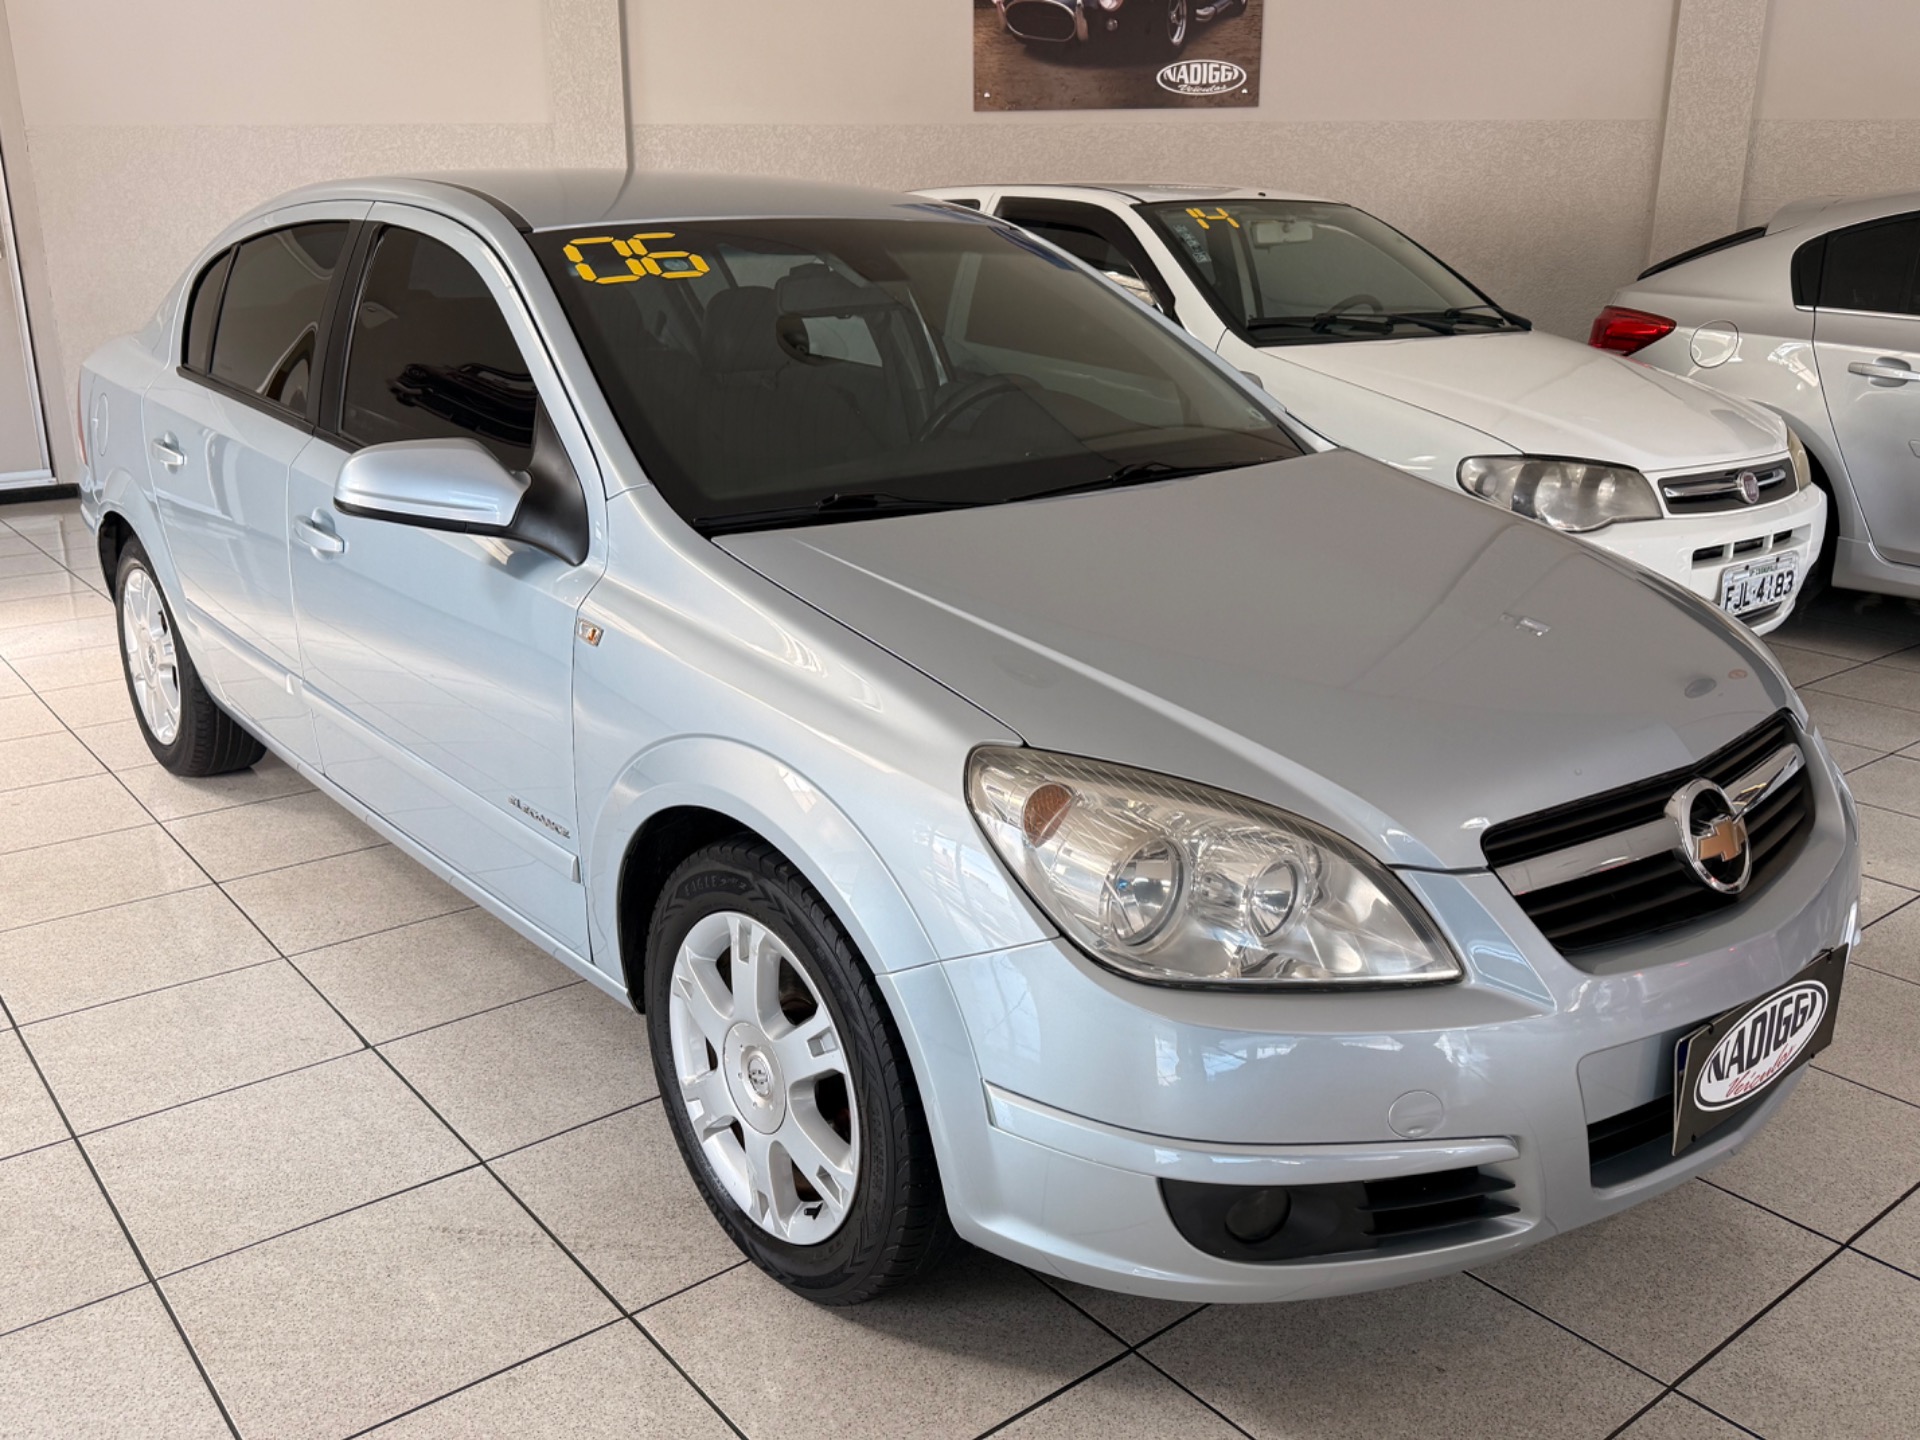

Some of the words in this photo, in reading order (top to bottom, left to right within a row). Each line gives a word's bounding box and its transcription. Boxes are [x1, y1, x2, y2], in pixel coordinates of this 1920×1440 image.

[1163, 62, 1239, 85] NADIGGI
[1185, 207, 1240, 230] 14
[562, 232, 711, 285] 06
[1707, 991, 1817, 1084] NADIGGI
